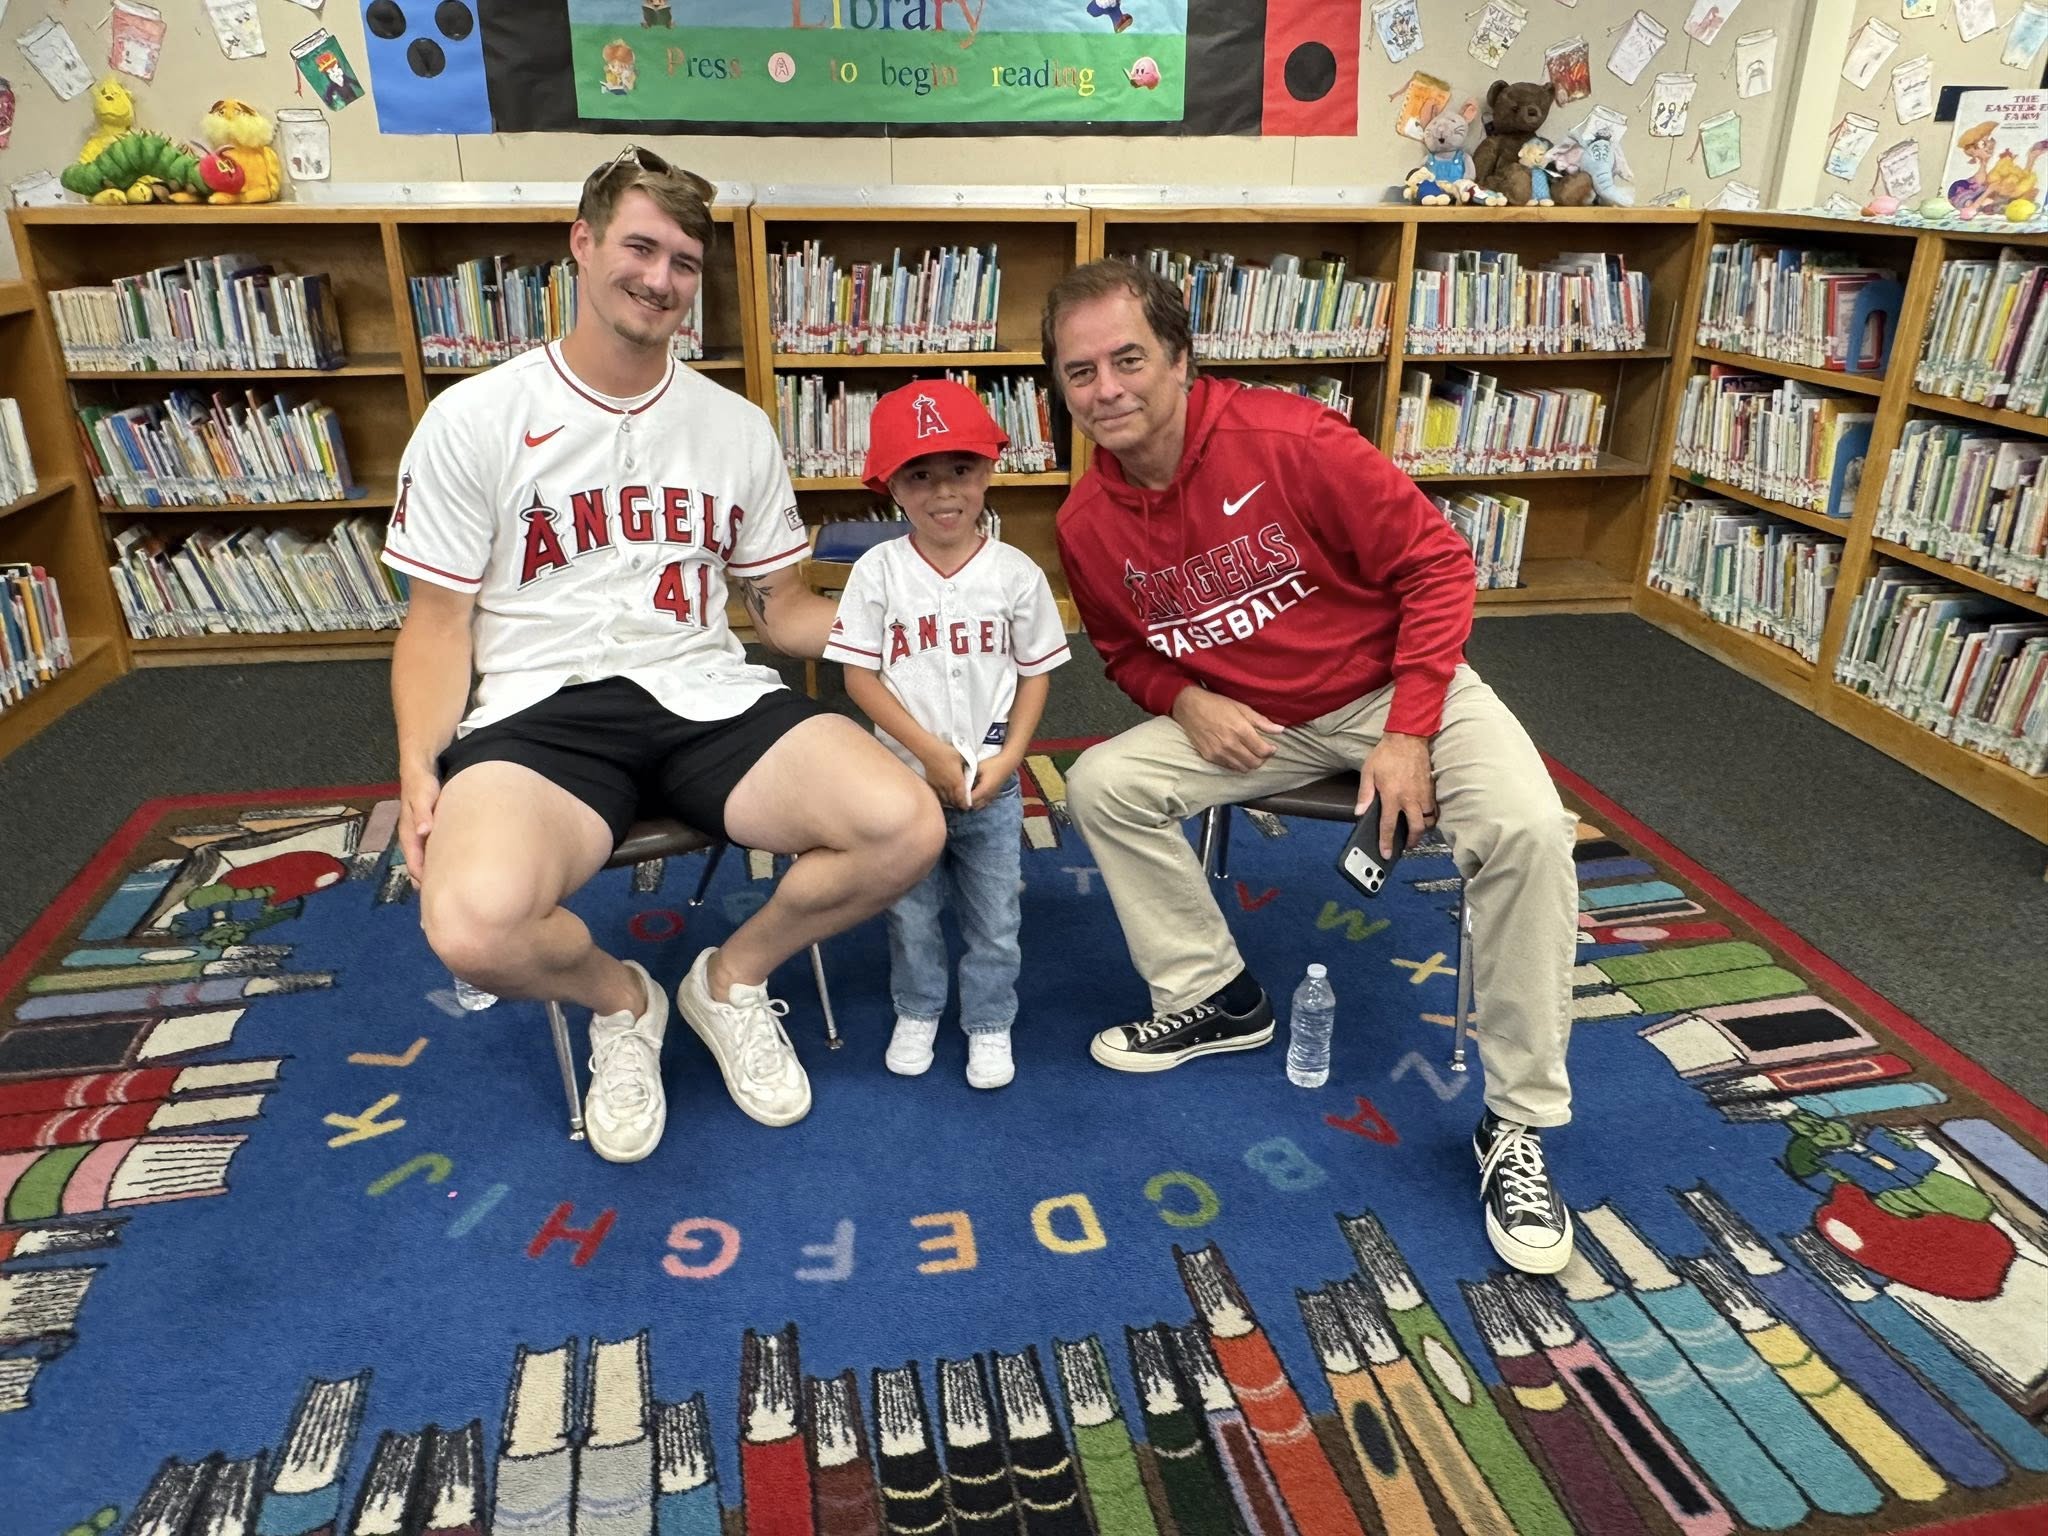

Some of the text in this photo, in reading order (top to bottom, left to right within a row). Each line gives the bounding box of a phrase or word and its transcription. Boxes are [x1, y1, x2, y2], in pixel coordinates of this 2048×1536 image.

[792, 0, 984, 49] Library
[667, 48, 742, 78] Press
[830, 58, 858, 83] to
[881, 57, 957, 95] begin
[991, 57, 1094, 96] reading
[1985, 104, 2036, 112] EASTER
[2004, 112, 2040, 120] FARM
[2014, 95, 2040, 103] THE
[912, 394, 949, 438] A
[391, 465, 412, 533] A
[518, 485, 746, 590] ANGELS
[653, 562, 709, 629] 41
[1123, 522, 1300, 622] ANGELS
[889, 613, 1009, 665] ANGE
[1146, 580, 1319, 658] BASEBALL
[1061, 866, 1101, 895] T
[1236, 880, 1280, 911] V
[628, 910, 685, 943] O
[1315, 901, 1391, 942] W
[1391, 951, 1458, 984] X
[347, 1036, 430, 1067] L
[1391, 1052, 1470, 1101] Z
[322, 1093, 407, 1149] K
[1323, 1096, 1400, 1146] A
[365, 1152, 454, 1197] J
[1243, 1137, 1328, 1192] B
[1031, 1193, 1107, 1254] D
[1144, 1171, 1221, 1228] C
[527, 1202, 617, 1268] H
[662, 1217, 741, 1279] G
[795, 1217, 856, 1282] F
[910, 1210, 979, 1274] E
